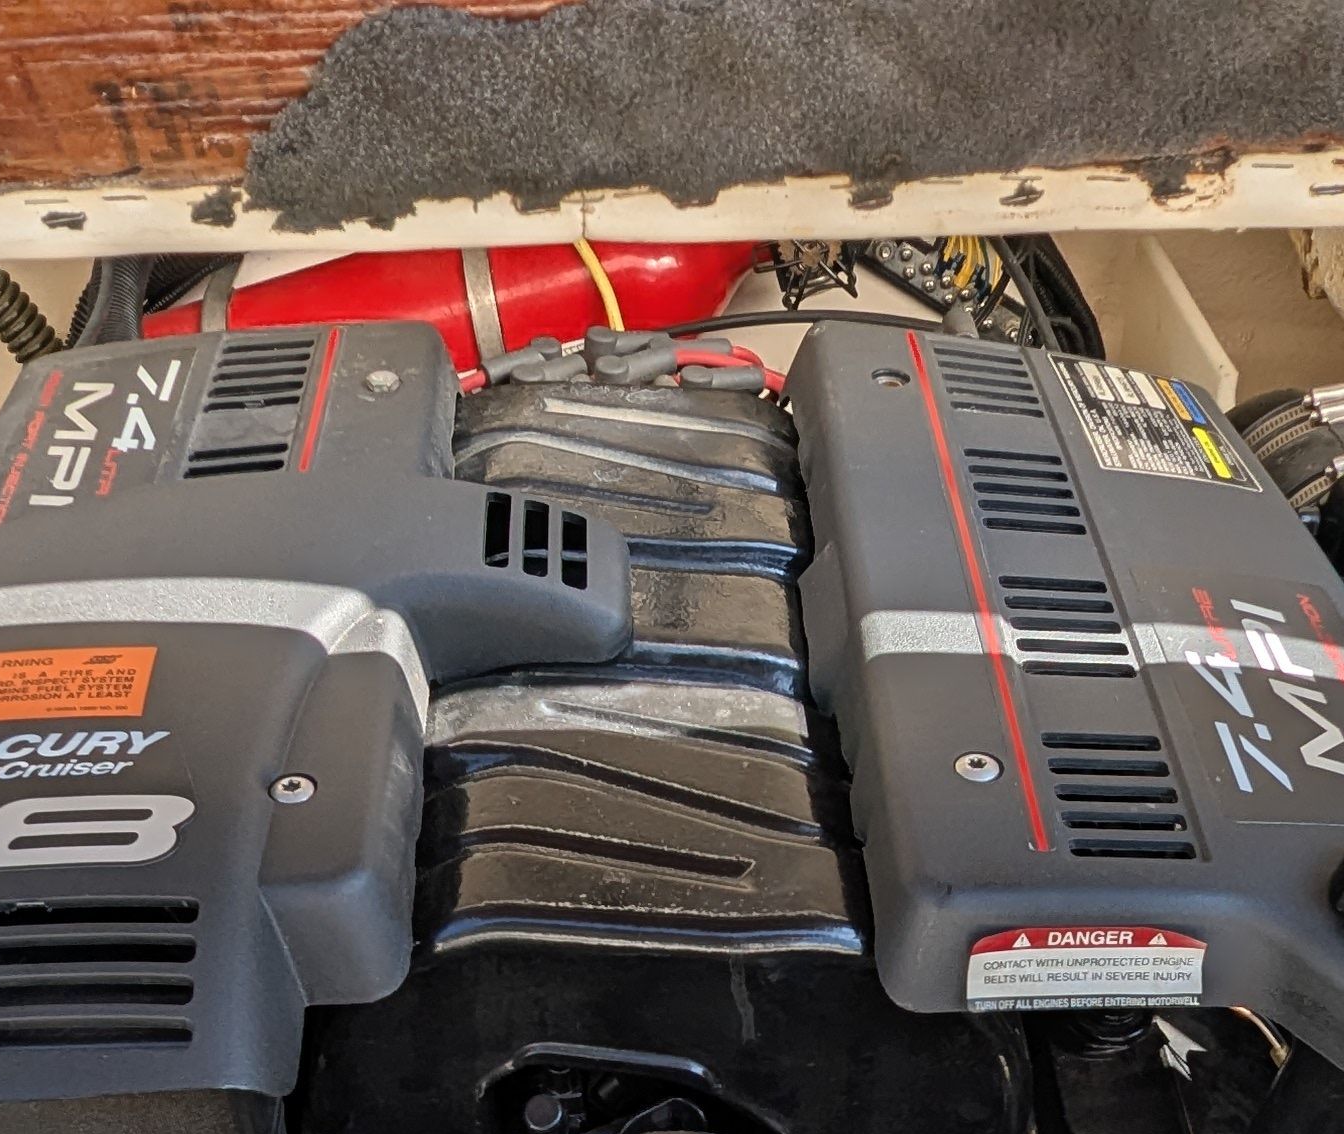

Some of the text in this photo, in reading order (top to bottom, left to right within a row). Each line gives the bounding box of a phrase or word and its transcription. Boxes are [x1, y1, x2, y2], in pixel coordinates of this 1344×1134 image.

[111, 359, 181, 452] 7.4
[29, 382, 115, 506] MPI
[60, 669, 94, 677] FIRE
[22, 678, 77, 686] INSPECT
[37, 685, 71, 693] FUEL
[1185, 650, 1293, 793] 7.4
[1047, 931, 1135, 946] DANGER
[983, 957, 1194, 971] CONTACT WITH UNPROTECTED ENGINE
[984, 972, 1192, 984] BELTS WILL RESULT IN SEVERE INJURY
[975, 996, 1200, 1011] TURN OFF ALL ENGINES BEFORE ENTERING MOTORWELL
